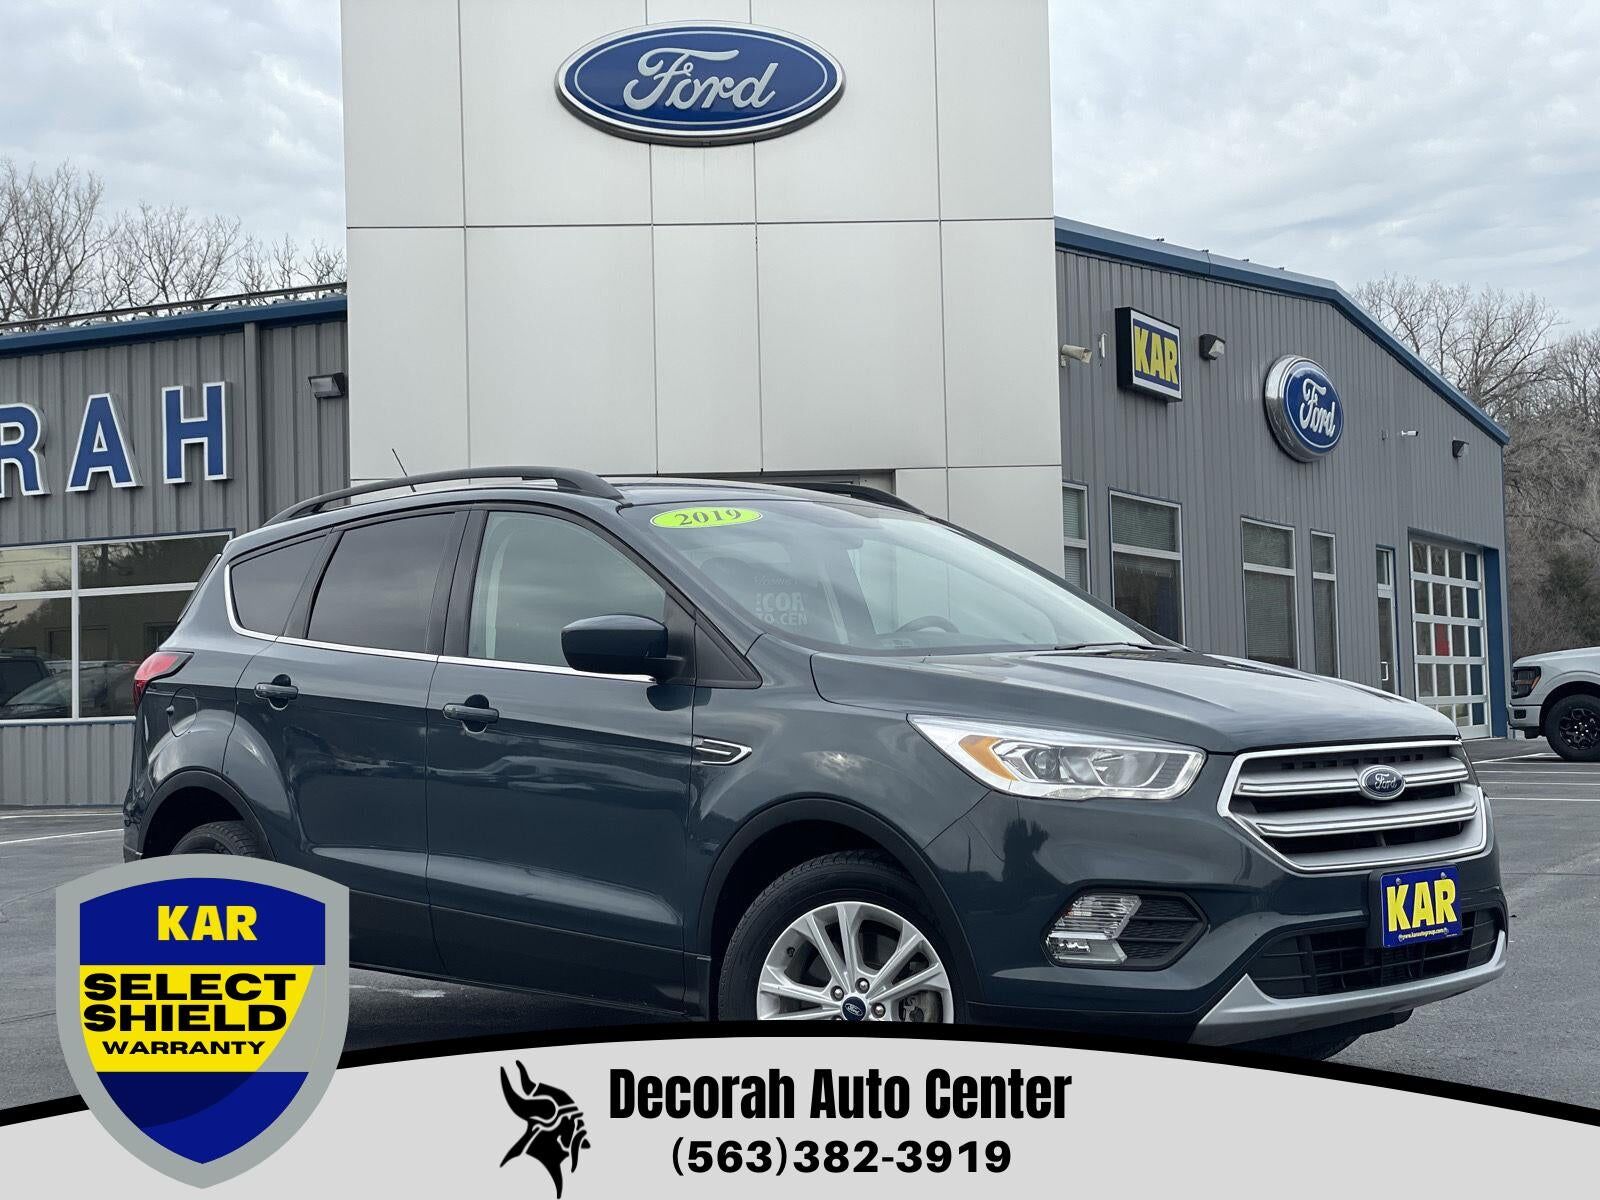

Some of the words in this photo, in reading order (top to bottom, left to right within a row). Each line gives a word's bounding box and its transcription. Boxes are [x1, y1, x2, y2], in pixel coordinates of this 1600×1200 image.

[623, 47, 779, 111] Ford
[1133, 326, 1179, 385] KAR
[1299, 378, 1336, 438] Ford
[0, 380, 234, 500] RAH
[674, 508, 742, 527] 2019
[1374, 773, 1398, 790] Ford
[1386, 878, 1458, 932] KAR
